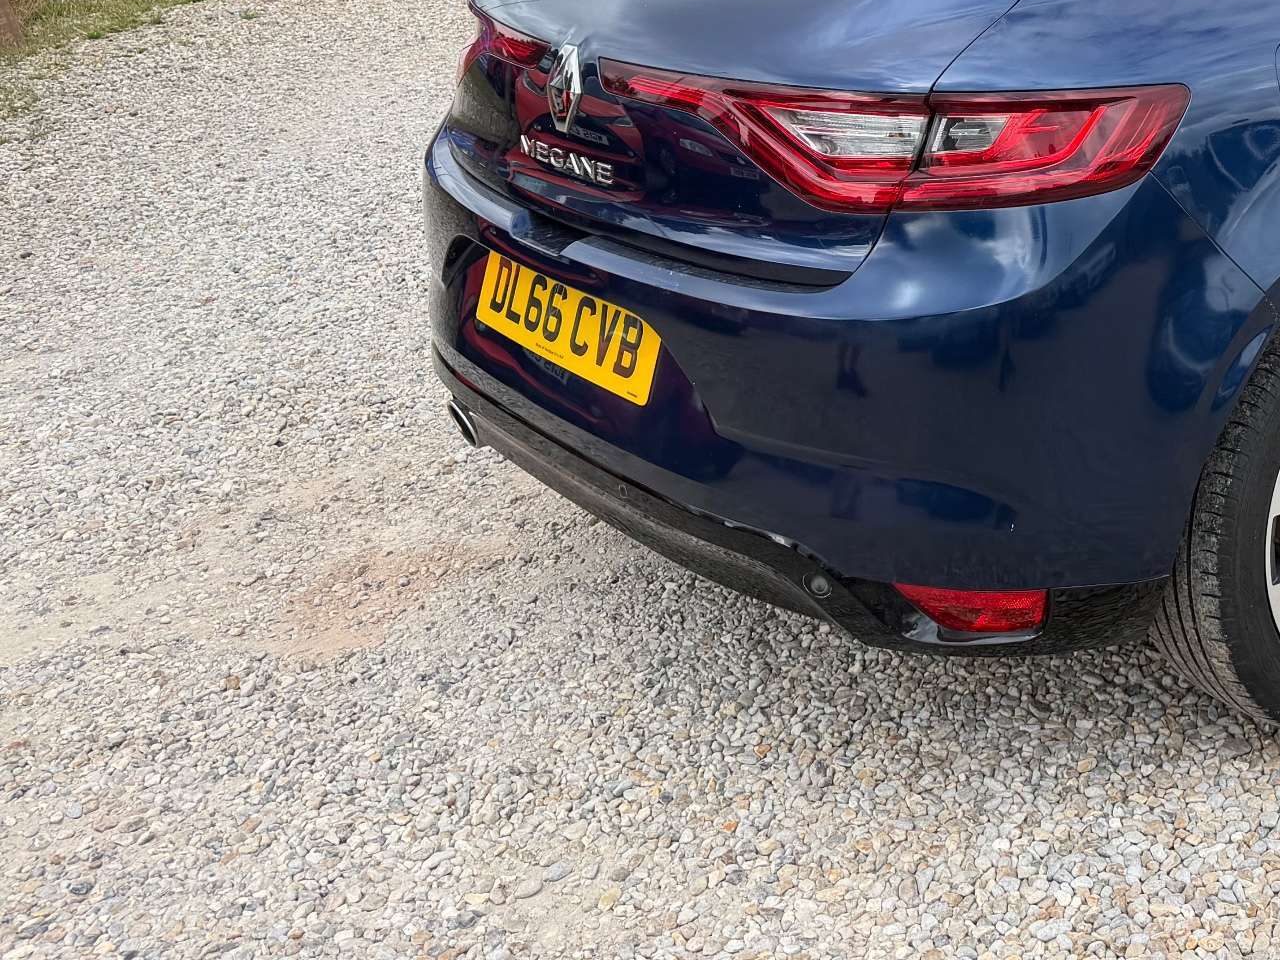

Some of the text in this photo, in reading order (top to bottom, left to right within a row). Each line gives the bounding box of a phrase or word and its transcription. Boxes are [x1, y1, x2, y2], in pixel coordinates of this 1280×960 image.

[521, 134, 616, 185] MEGANE
[489, 255, 568, 343] DL66
[569, 295, 645, 380] CVB
